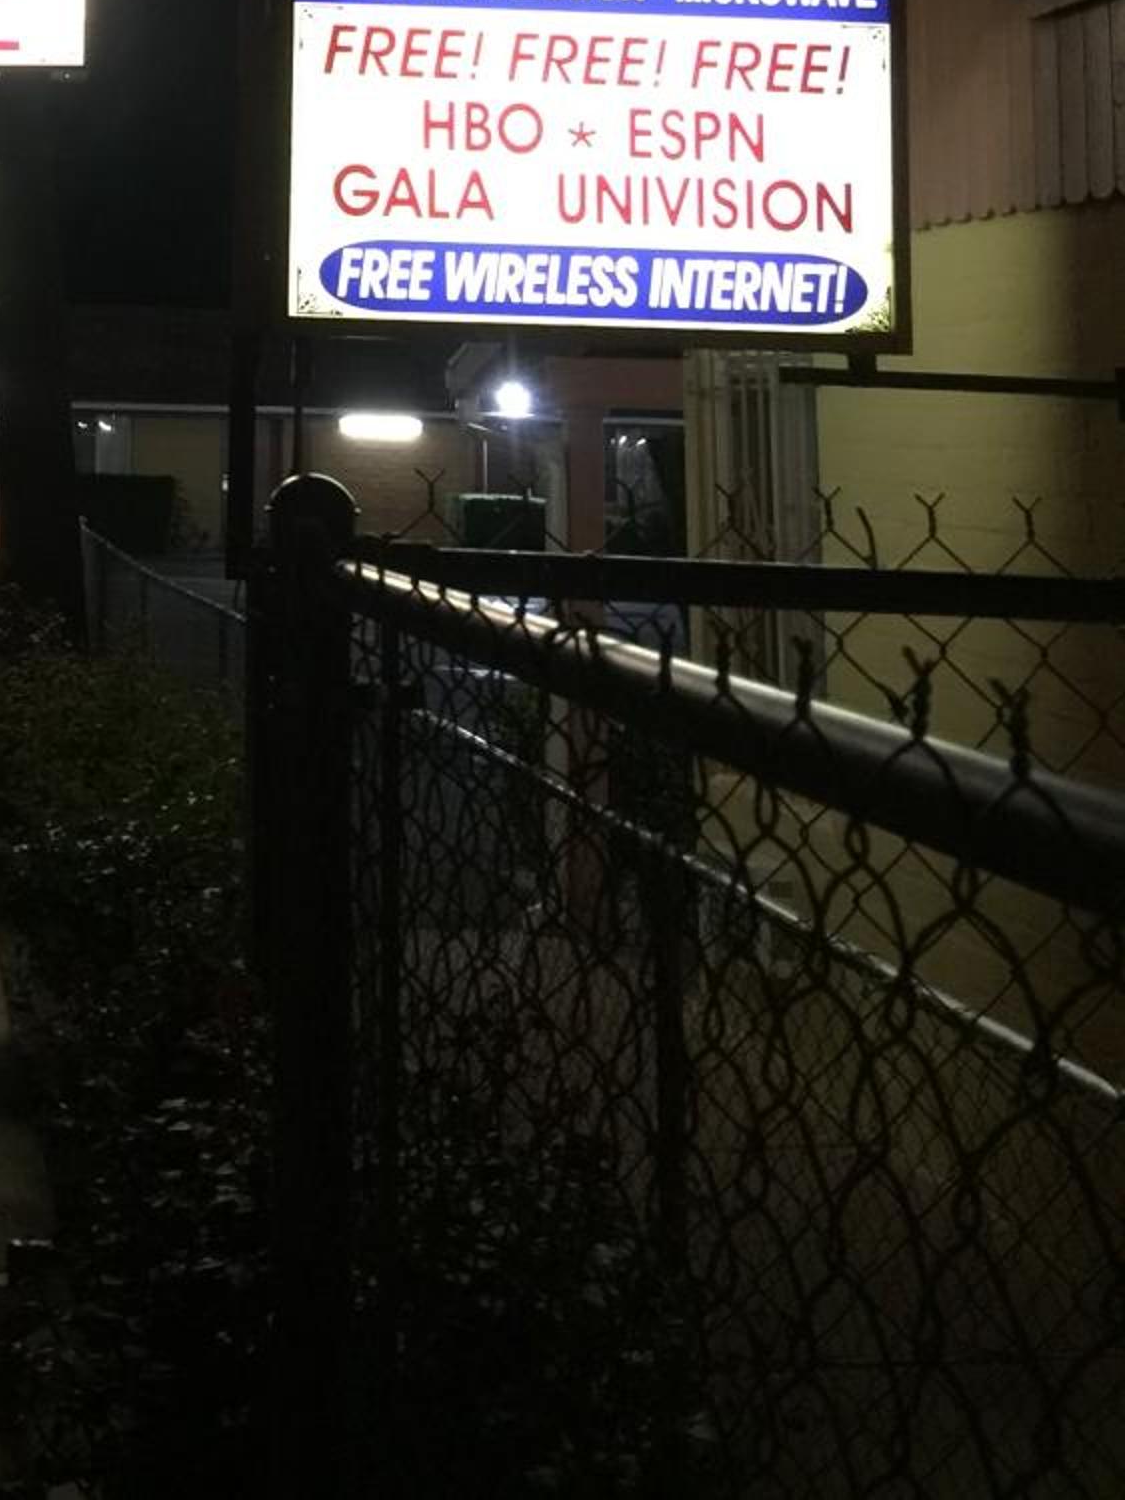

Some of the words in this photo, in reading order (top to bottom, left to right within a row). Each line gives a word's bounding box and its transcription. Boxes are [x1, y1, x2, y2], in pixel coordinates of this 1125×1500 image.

[323, 25, 484, 80] FREE!
[508, 32, 667, 88] FREE!
[691, 40, 852, 95] FREE!
[422, 100, 543, 153] HBO
[628, 108, 765, 162] ESPN
[332, 164, 496, 220] GALA
[557, 174, 854, 234] UNIVISION
[336, 248, 434, 300] FREE
[443, 249, 639, 308] WIRELESS
[648, 260, 847, 315] INTERNET!
